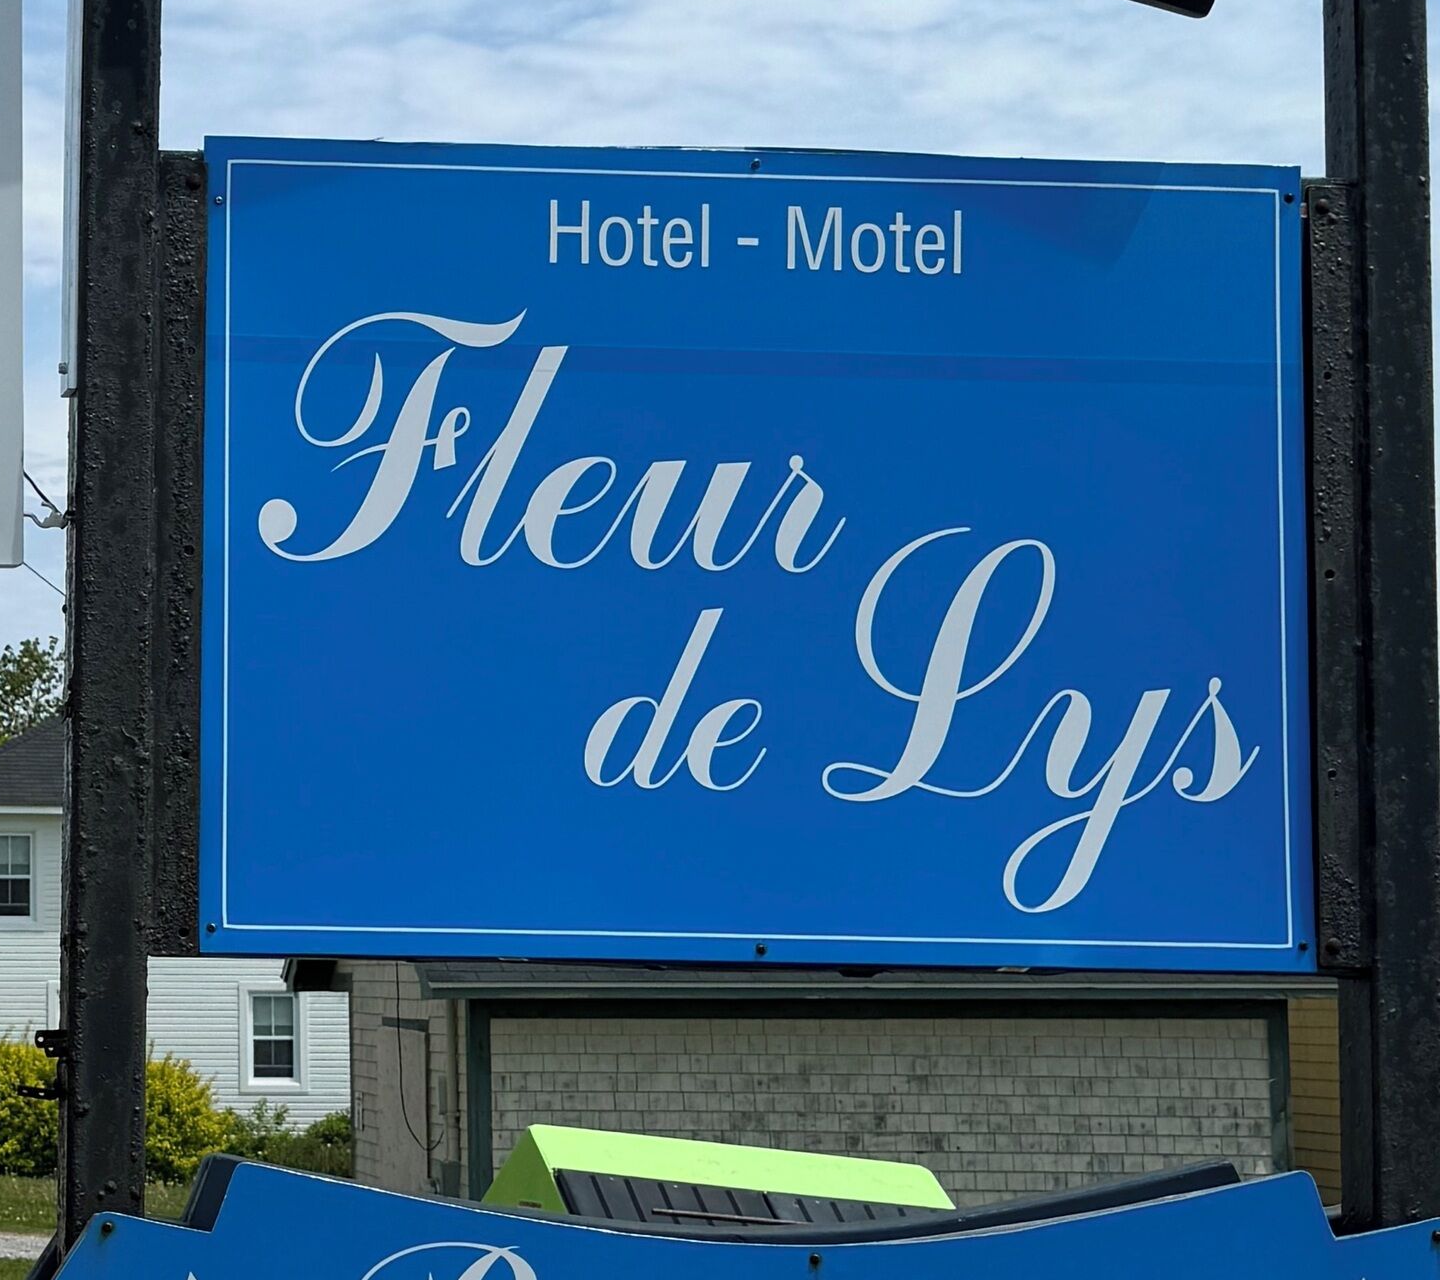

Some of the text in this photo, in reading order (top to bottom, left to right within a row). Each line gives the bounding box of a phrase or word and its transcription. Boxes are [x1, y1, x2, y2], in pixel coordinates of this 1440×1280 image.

[549, 199, 710, 269] Hotel
[787, 205, 962, 275] Motel
[258, 308, 846, 573] Fleur
[584, 526, 1260, 913] de Lys
